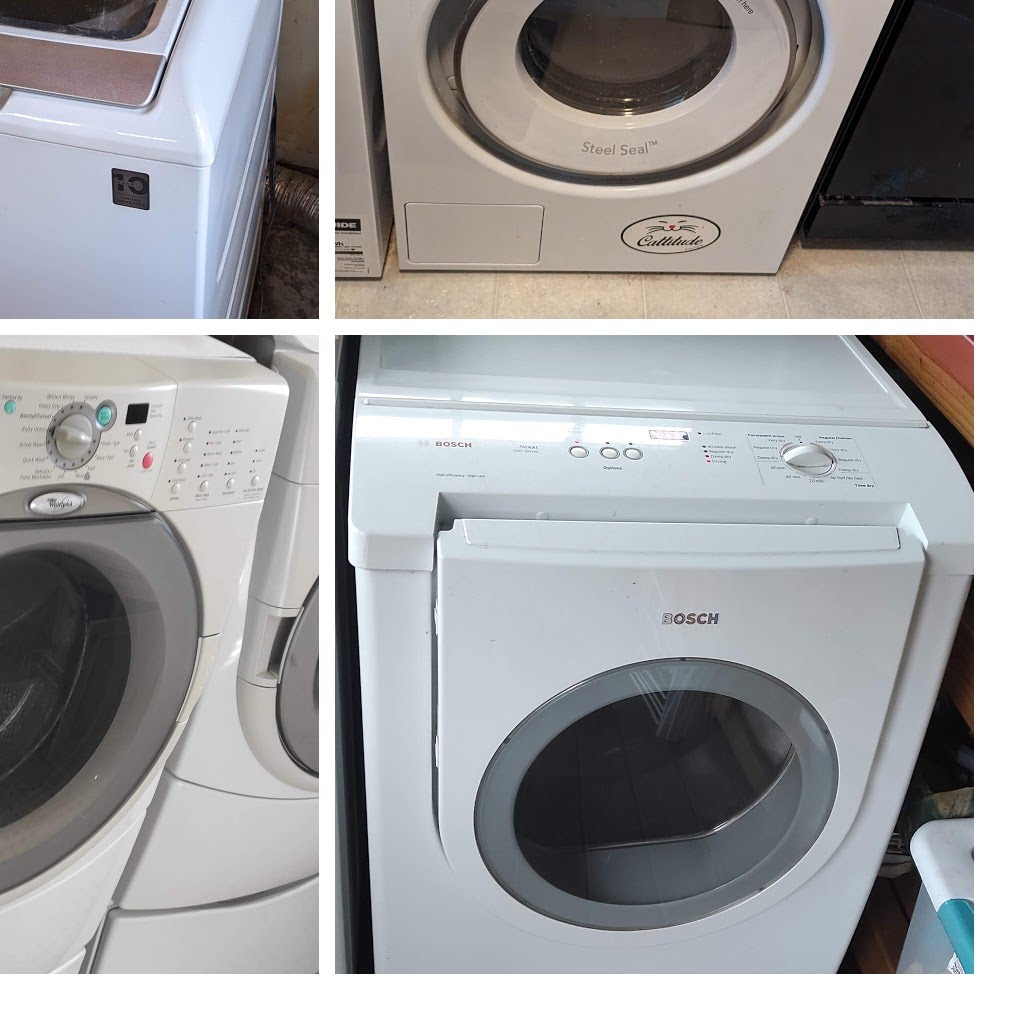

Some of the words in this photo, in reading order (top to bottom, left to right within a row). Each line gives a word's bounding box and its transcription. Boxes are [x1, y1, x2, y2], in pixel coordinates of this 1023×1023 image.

[581, 141, 616, 156] Steel
[637, 235, 703, 247] Cattitude
[661, 612, 719, 625] BOSCH
